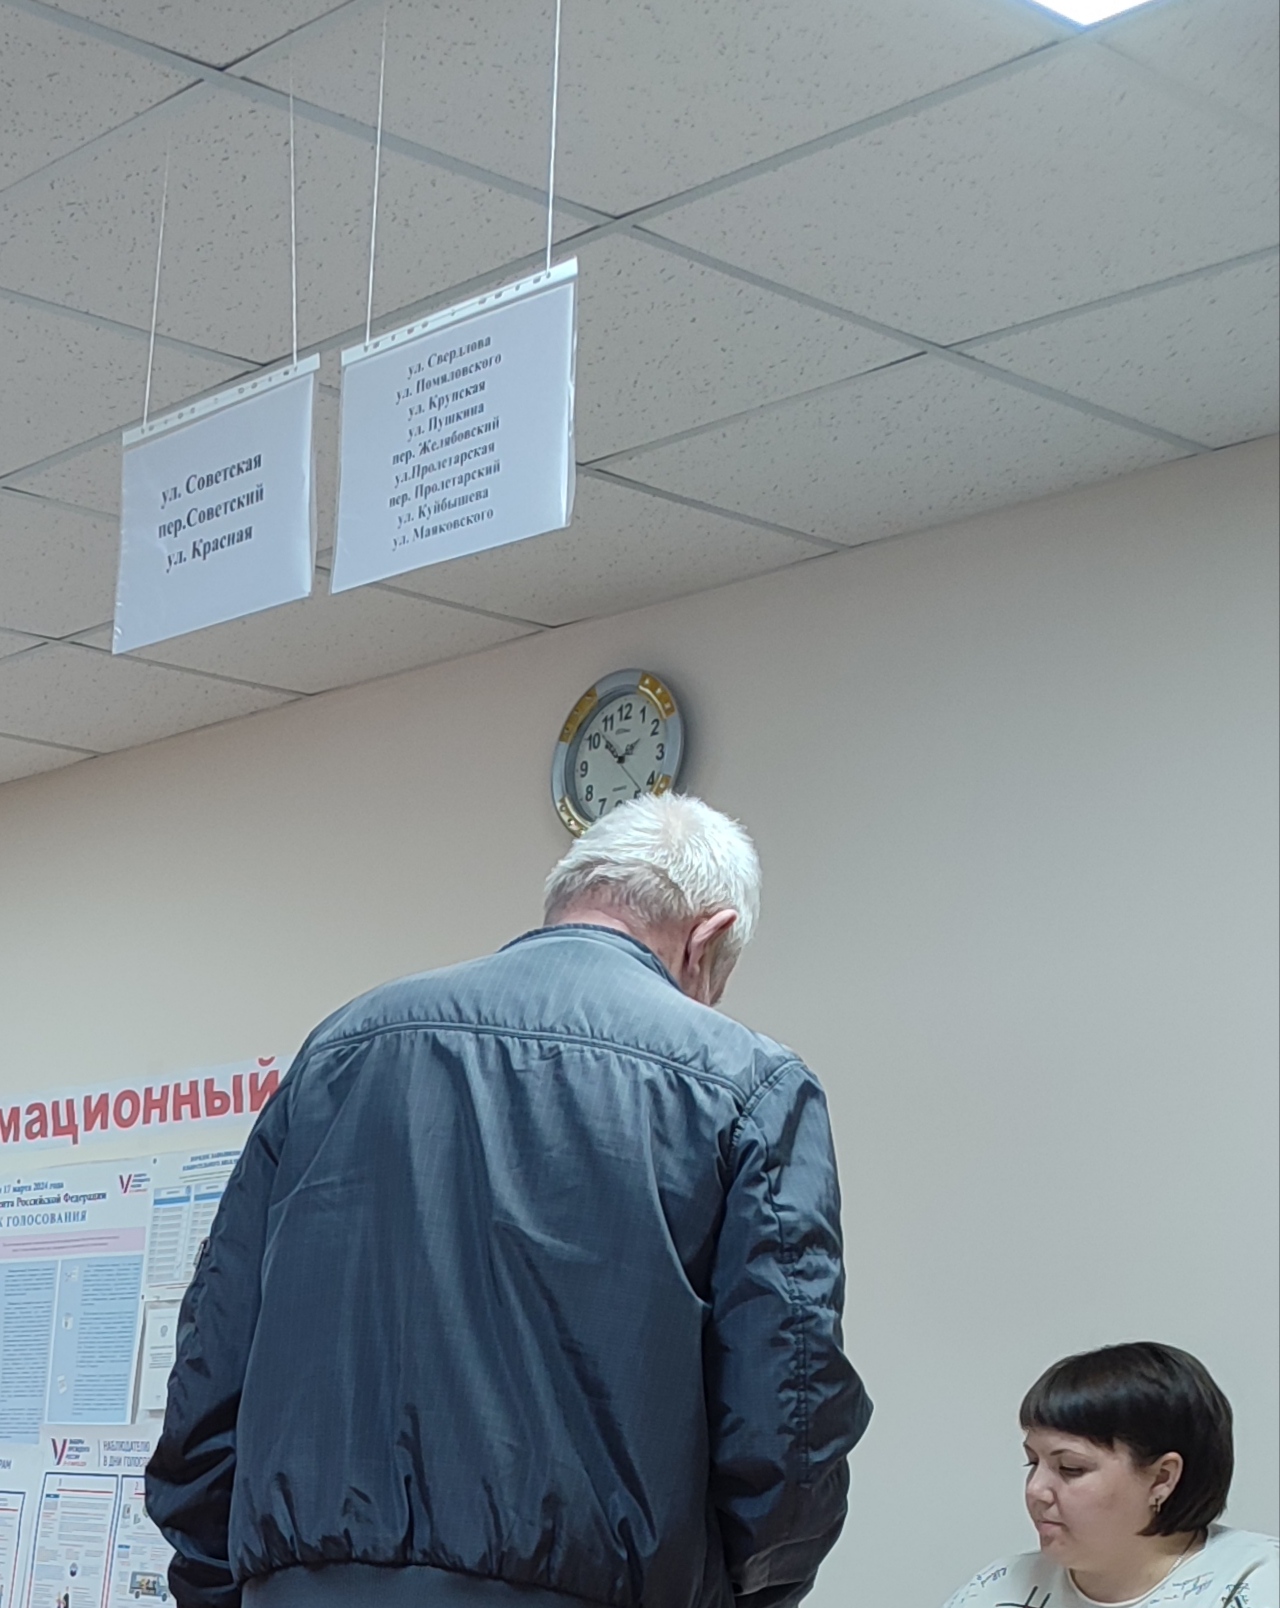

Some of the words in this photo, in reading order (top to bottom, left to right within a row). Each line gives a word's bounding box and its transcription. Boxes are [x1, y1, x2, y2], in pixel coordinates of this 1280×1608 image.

[407, 362, 424, 380] ул.
[427, 336, 491, 368] Свердлова
[395, 388, 412, 405] ул.
[416, 354, 502, 394] Помяловского
[408, 404, 425, 421] ул.
[429, 381, 485, 411] Крупская
[407, 425, 425, 442] ул.
[429, 403, 484, 432] Пушкина
[392, 449, 415, 465] пер.
[419, 416, 500, 456] Желябовский
[161, 486, 181, 510] ул.
[186, 453, 262, 494] Советская
[389, 492, 411, 508] пер.
[415, 459, 500, 500] Пролетарский
[397, 512, 414, 529] ул.
[418, 488, 488, 520] Куйбышева
[392, 535, 409, 552] ул.
[413, 508, 494, 541] Маяковского
[166, 550, 187, 574] ул.
[191, 526, 253, 561] Красная
[617, 703, 633, 722] 12
[640, 706, 646, 723] 1
[602, 713, 614, 732] 11
[650, 718, 660, 736] 2
[587, 732, 601, 750] 10
[655, 743, 665, 761] 3
[580, 760, 589, 778] 9
[646, 770, 656, 786] 4
[585, 784, 594, 802] 8
[598, 798, 607, 815] 7
[6, 1210, 87, 1228] ГОЛОСОВАНИЯ
